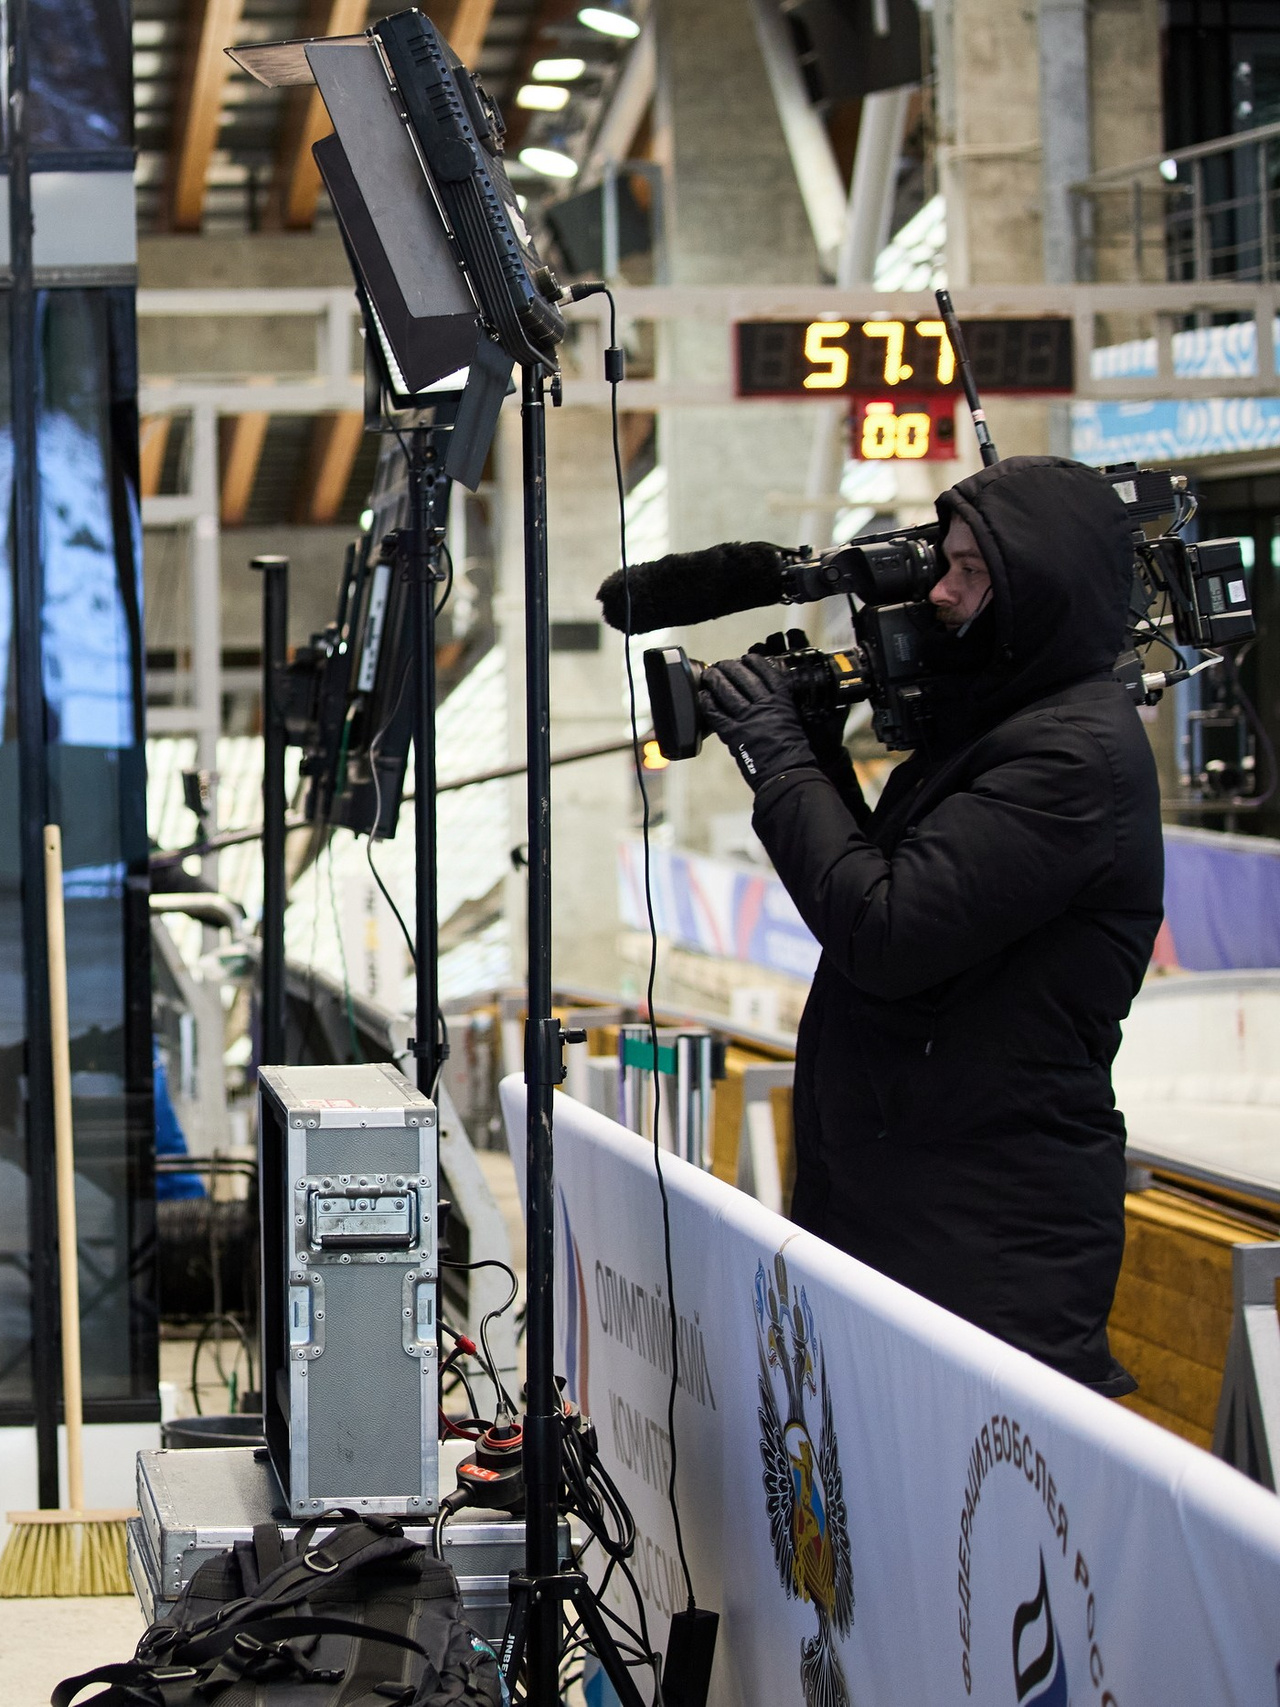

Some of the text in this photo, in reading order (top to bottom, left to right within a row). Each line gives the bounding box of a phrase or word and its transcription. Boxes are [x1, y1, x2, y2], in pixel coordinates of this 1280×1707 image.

[629, 1526, 687, 1620] ОССИИ
[958, 1423, 993, 1696] ФЕДЕРАЦИЯ
[991, 1414, 1069, 1557] БОБСЛЕЯ
